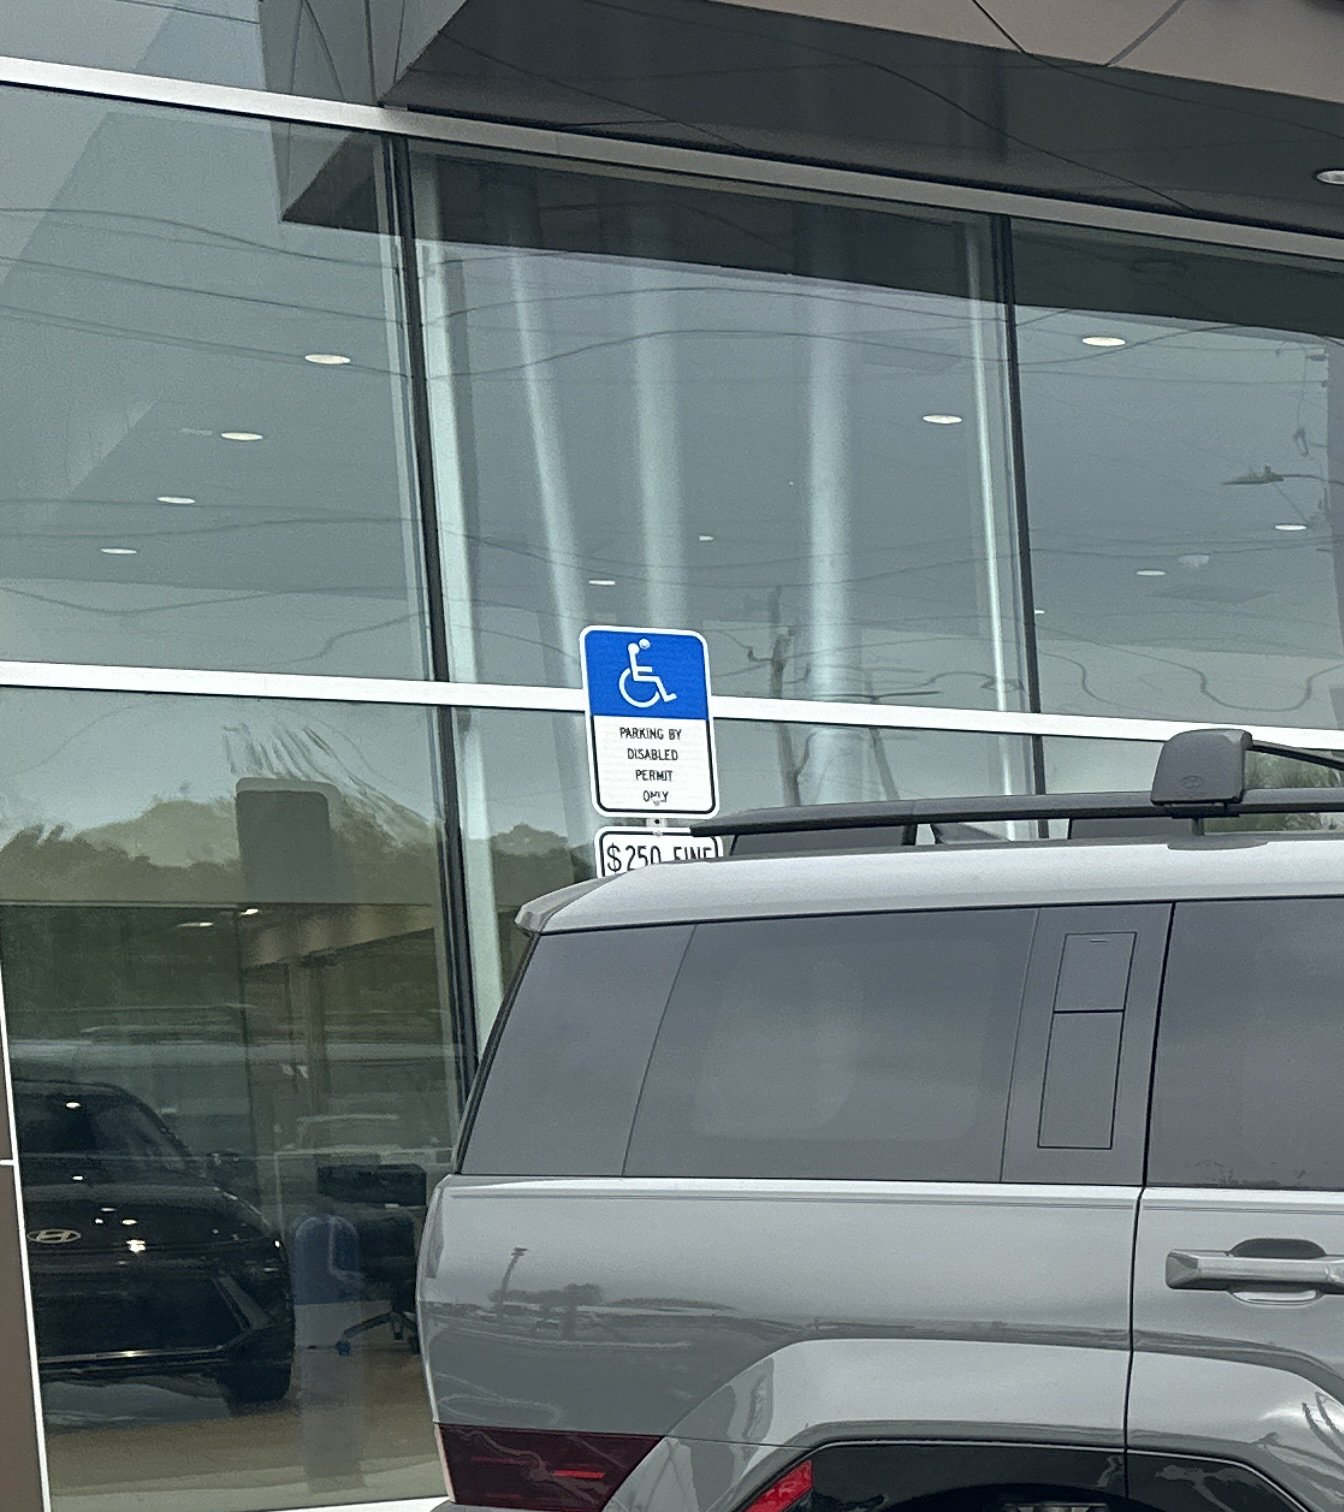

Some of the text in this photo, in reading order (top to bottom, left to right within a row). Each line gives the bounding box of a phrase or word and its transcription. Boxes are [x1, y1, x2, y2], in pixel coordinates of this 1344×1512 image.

[619, 726, 683, 741] PARKING BY
[627, 747, 679, 762] DISABLED
[635, 769, 673, 782] PERMIT
[642, 790, 670, 803] ONLY
[606, 842, 662, 873] $250
